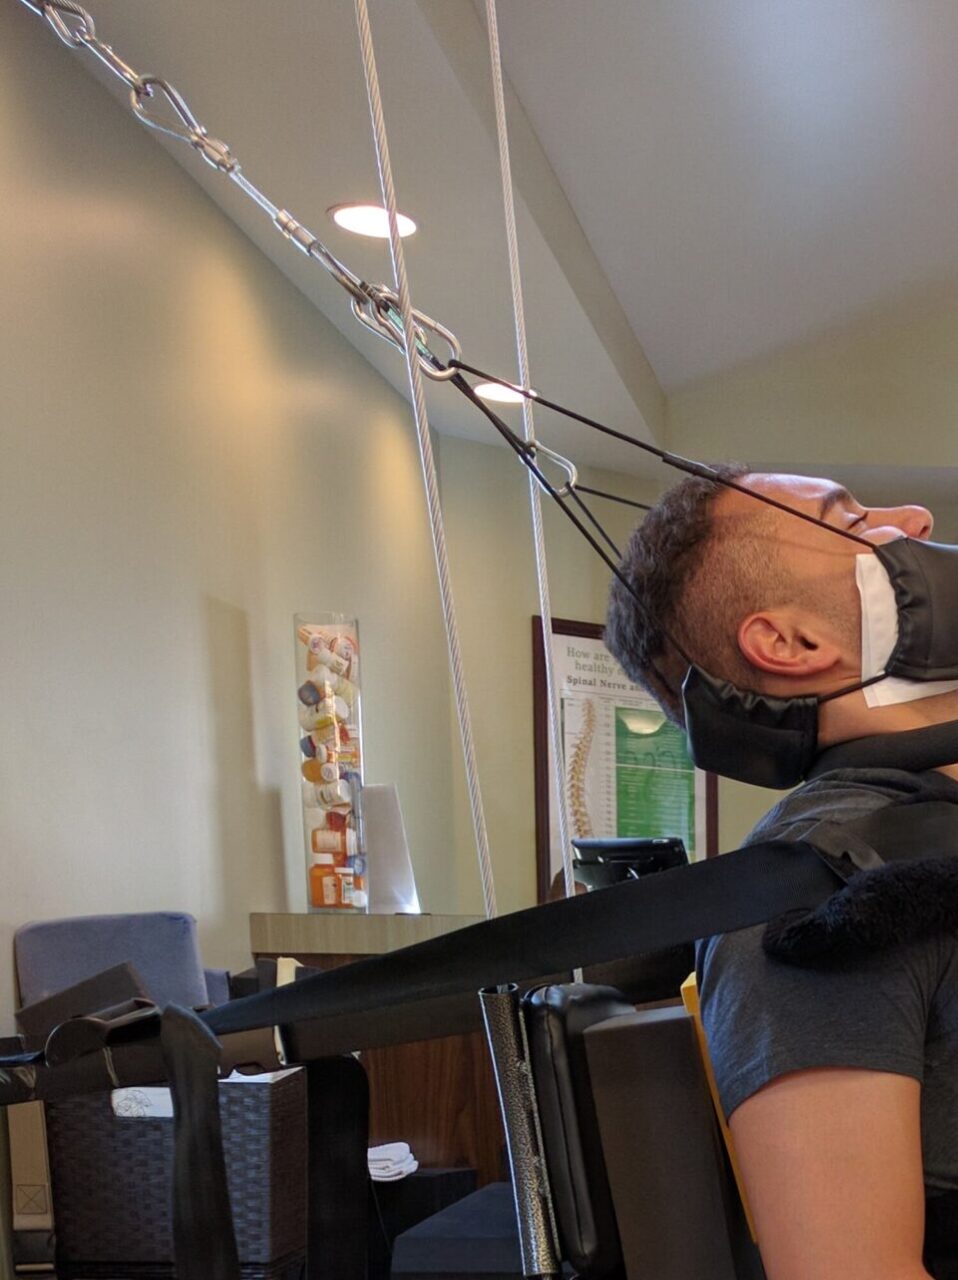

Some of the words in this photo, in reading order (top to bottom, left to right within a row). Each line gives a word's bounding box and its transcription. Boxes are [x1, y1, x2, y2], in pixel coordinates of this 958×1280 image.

[567, 647, 590, 659] How
[593, 652, 611, 662] are
[575, 660, 614, 675] healthy
[566, 675, 597, 689] Spinal
[600, 679, 627, 690] Nerve
